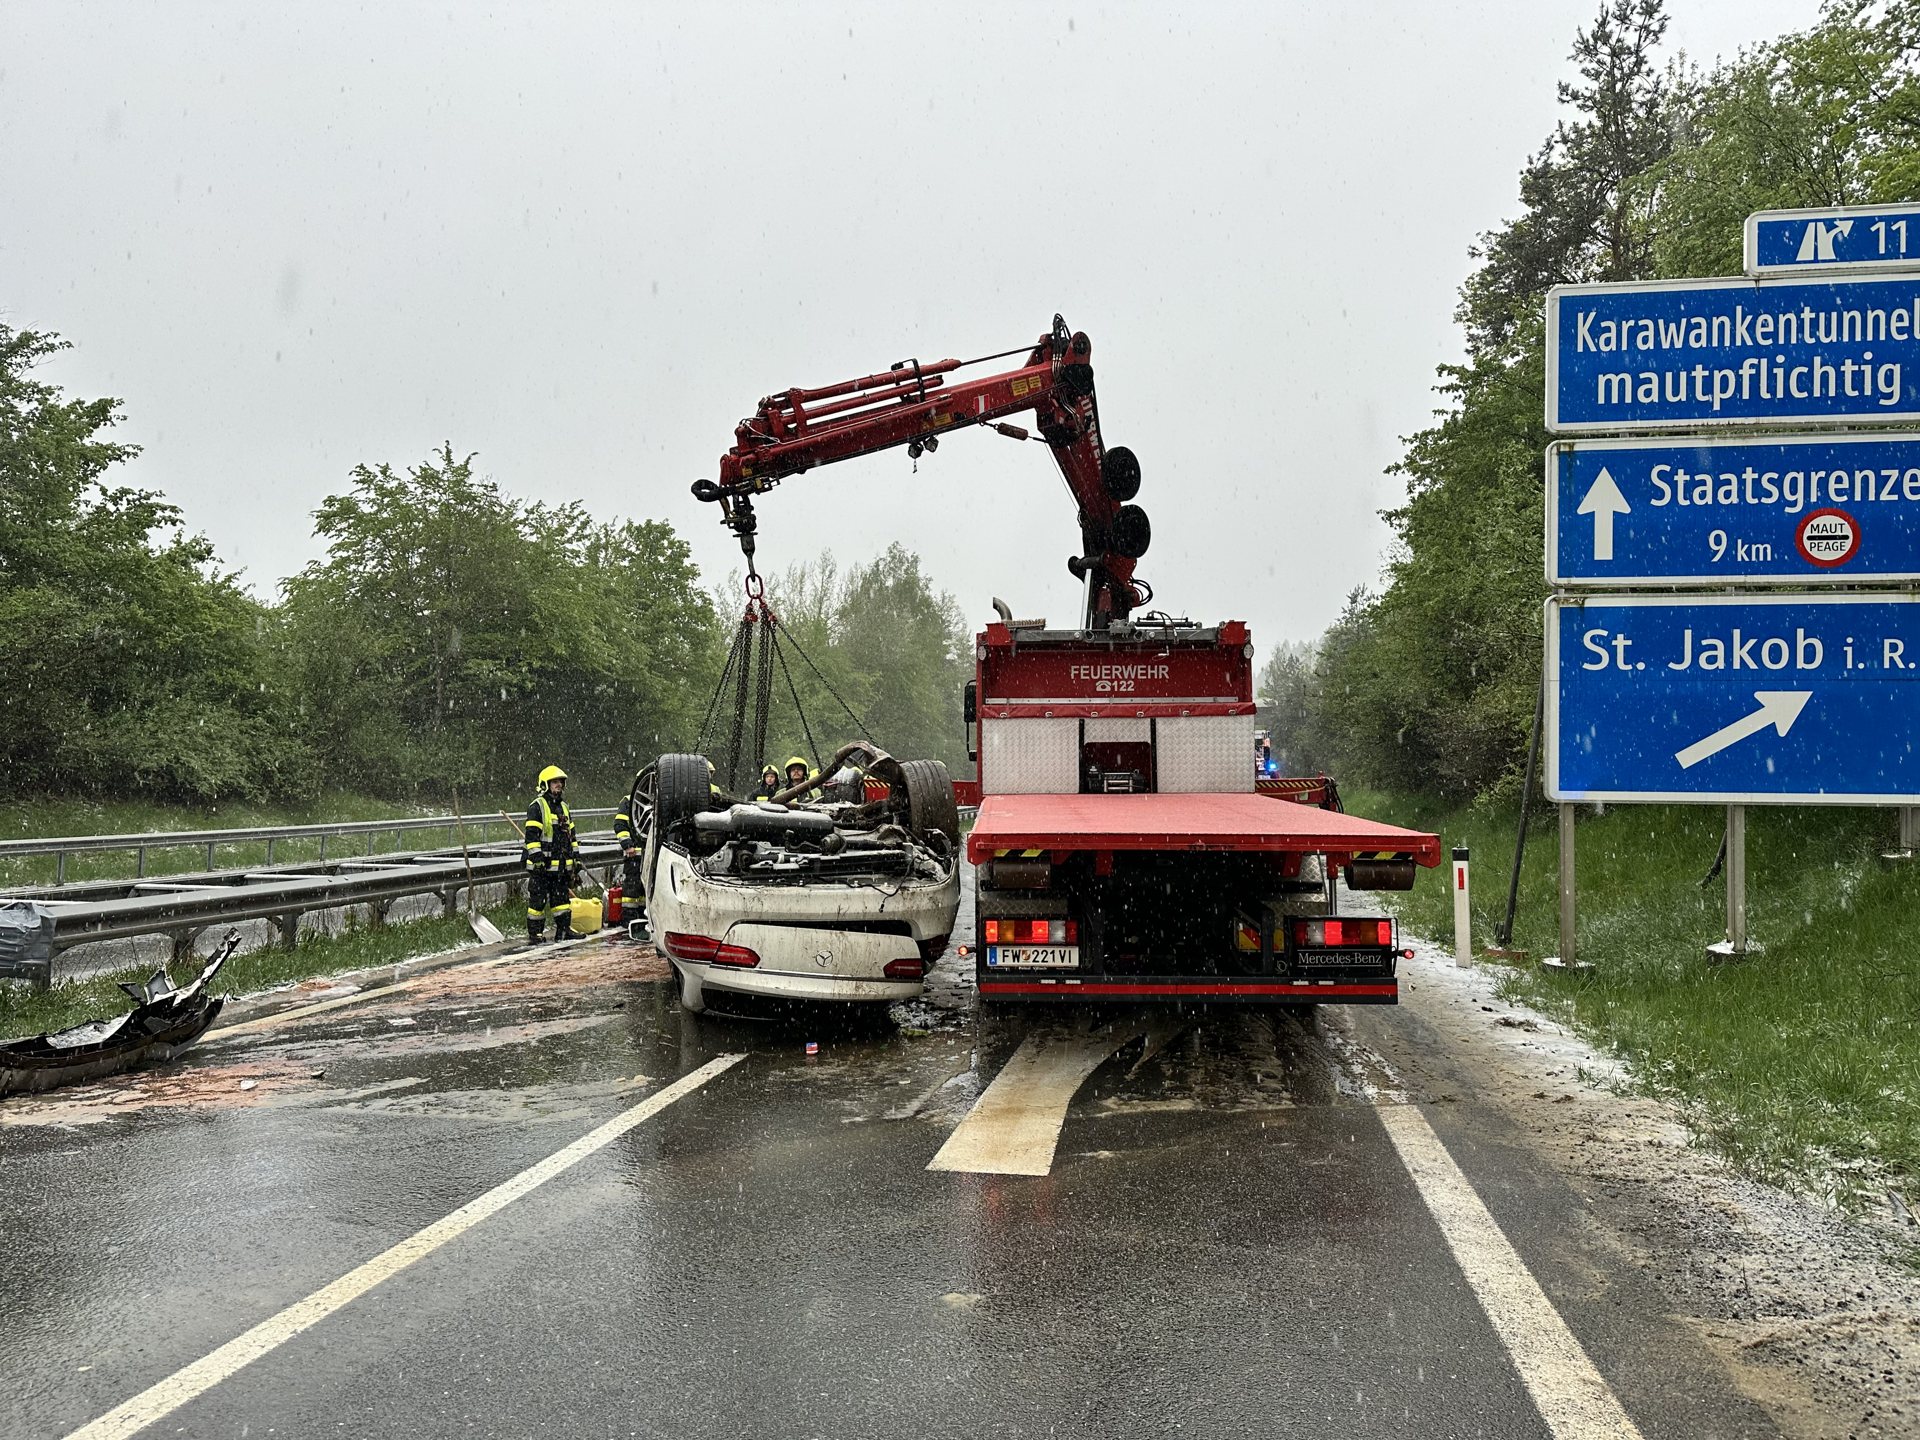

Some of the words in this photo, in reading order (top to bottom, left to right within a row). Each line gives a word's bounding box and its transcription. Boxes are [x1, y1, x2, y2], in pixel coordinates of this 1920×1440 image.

[1869, 219, 1907, 255] 11
[1576, 297, 1920, 353] Karawankentunnel
[1597, 351, 1902, 411] mautpflichtig
[1650, 464, 1920, 513] Staatsgrenze
[1810, 523, 1846, 534] MAUT
[1708, 529, 1728, 562] 9
[1736, 538, 1772, 562] km
[1809, 541, 1847, 552] PEAGE
[1582, 629, 1646, 671] St.
[1668, 628, 1824, 671] Jakob
[1843, 636, 1865, 669] i.
[1883, 638, 1916, 669] R.
[1070, 665, 1169, 679] FEUERWEHR
[1112, 680, 1135, 692] 122
[1002, 949, 1021, 963] FW
[1298, 952, 1382, 964] Mercedes-Benz
